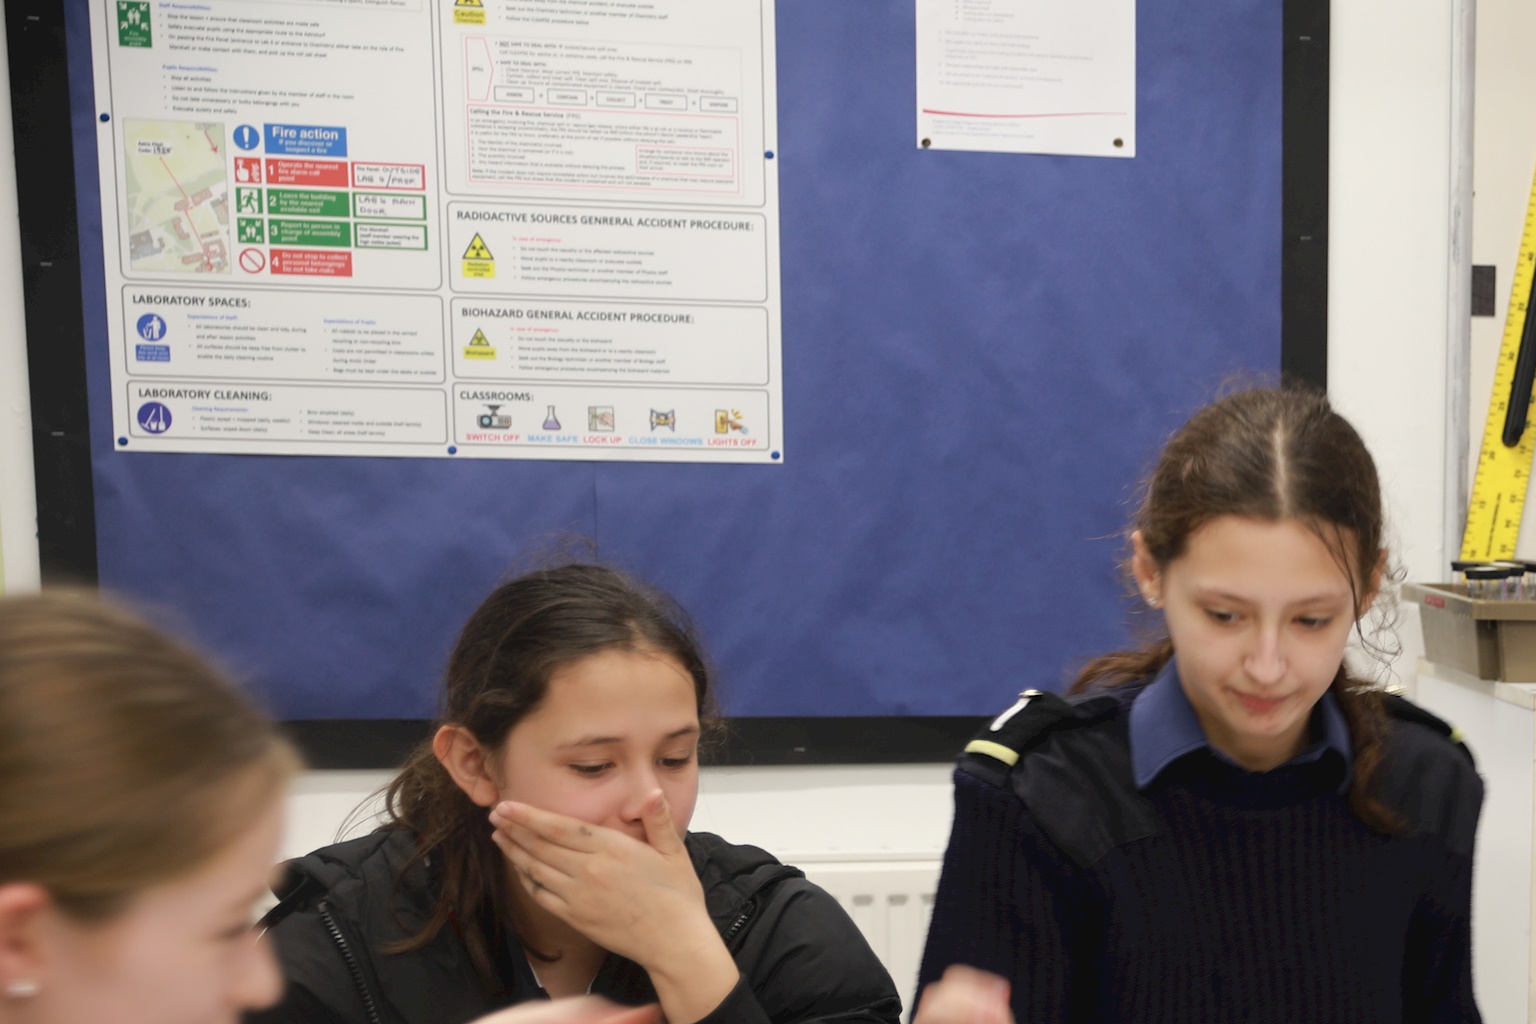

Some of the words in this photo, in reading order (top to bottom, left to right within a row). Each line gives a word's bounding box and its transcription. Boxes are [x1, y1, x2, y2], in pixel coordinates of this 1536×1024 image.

[272, 126, 296, 139] Fire
[300, 128, 338, 140] action
[268, 164, 274, 176] 1
[269, 195, 276, 207] 2
[457, 211, 527, 223] RADIOACTIVE
[530, 214, 578, 224] SOURCES
[637, 218, 687, 229] ACCIDENT
[690, 220, 754, 232] PROCEDURE:
[271, 225, 278, 236] 3
[272, 256, 279, 267] 4
[132, 294, 206, 307] LABORATORY
[209, 297, 251, 308] SPACES:
[462, 308, 524, 318] BIOHAZARD
[526, 310, 574, 320] GENERAL
[576, 311, 627, 322] ACCIDENT
[630, 313, 694, 324] PROCEDURE:
[138, 388, 212, 400] LABORATORY
[214, 390, 272, 402] CLEANING:
[460, 391, 534, 402] CLASSROOMS:
[466, 433, 501, 442] SWITCH
[502, 434, 520, 442] OFF
[528, 435, 553, 443] MAKE
[556, 435, 579, 443] SAFE
[583, 436, 607, 444] LOCK
[610, 436, 622, 444] UP
[660, 438, 703, 446] WINDOWS
[741, 439, 758, 447] OFF
